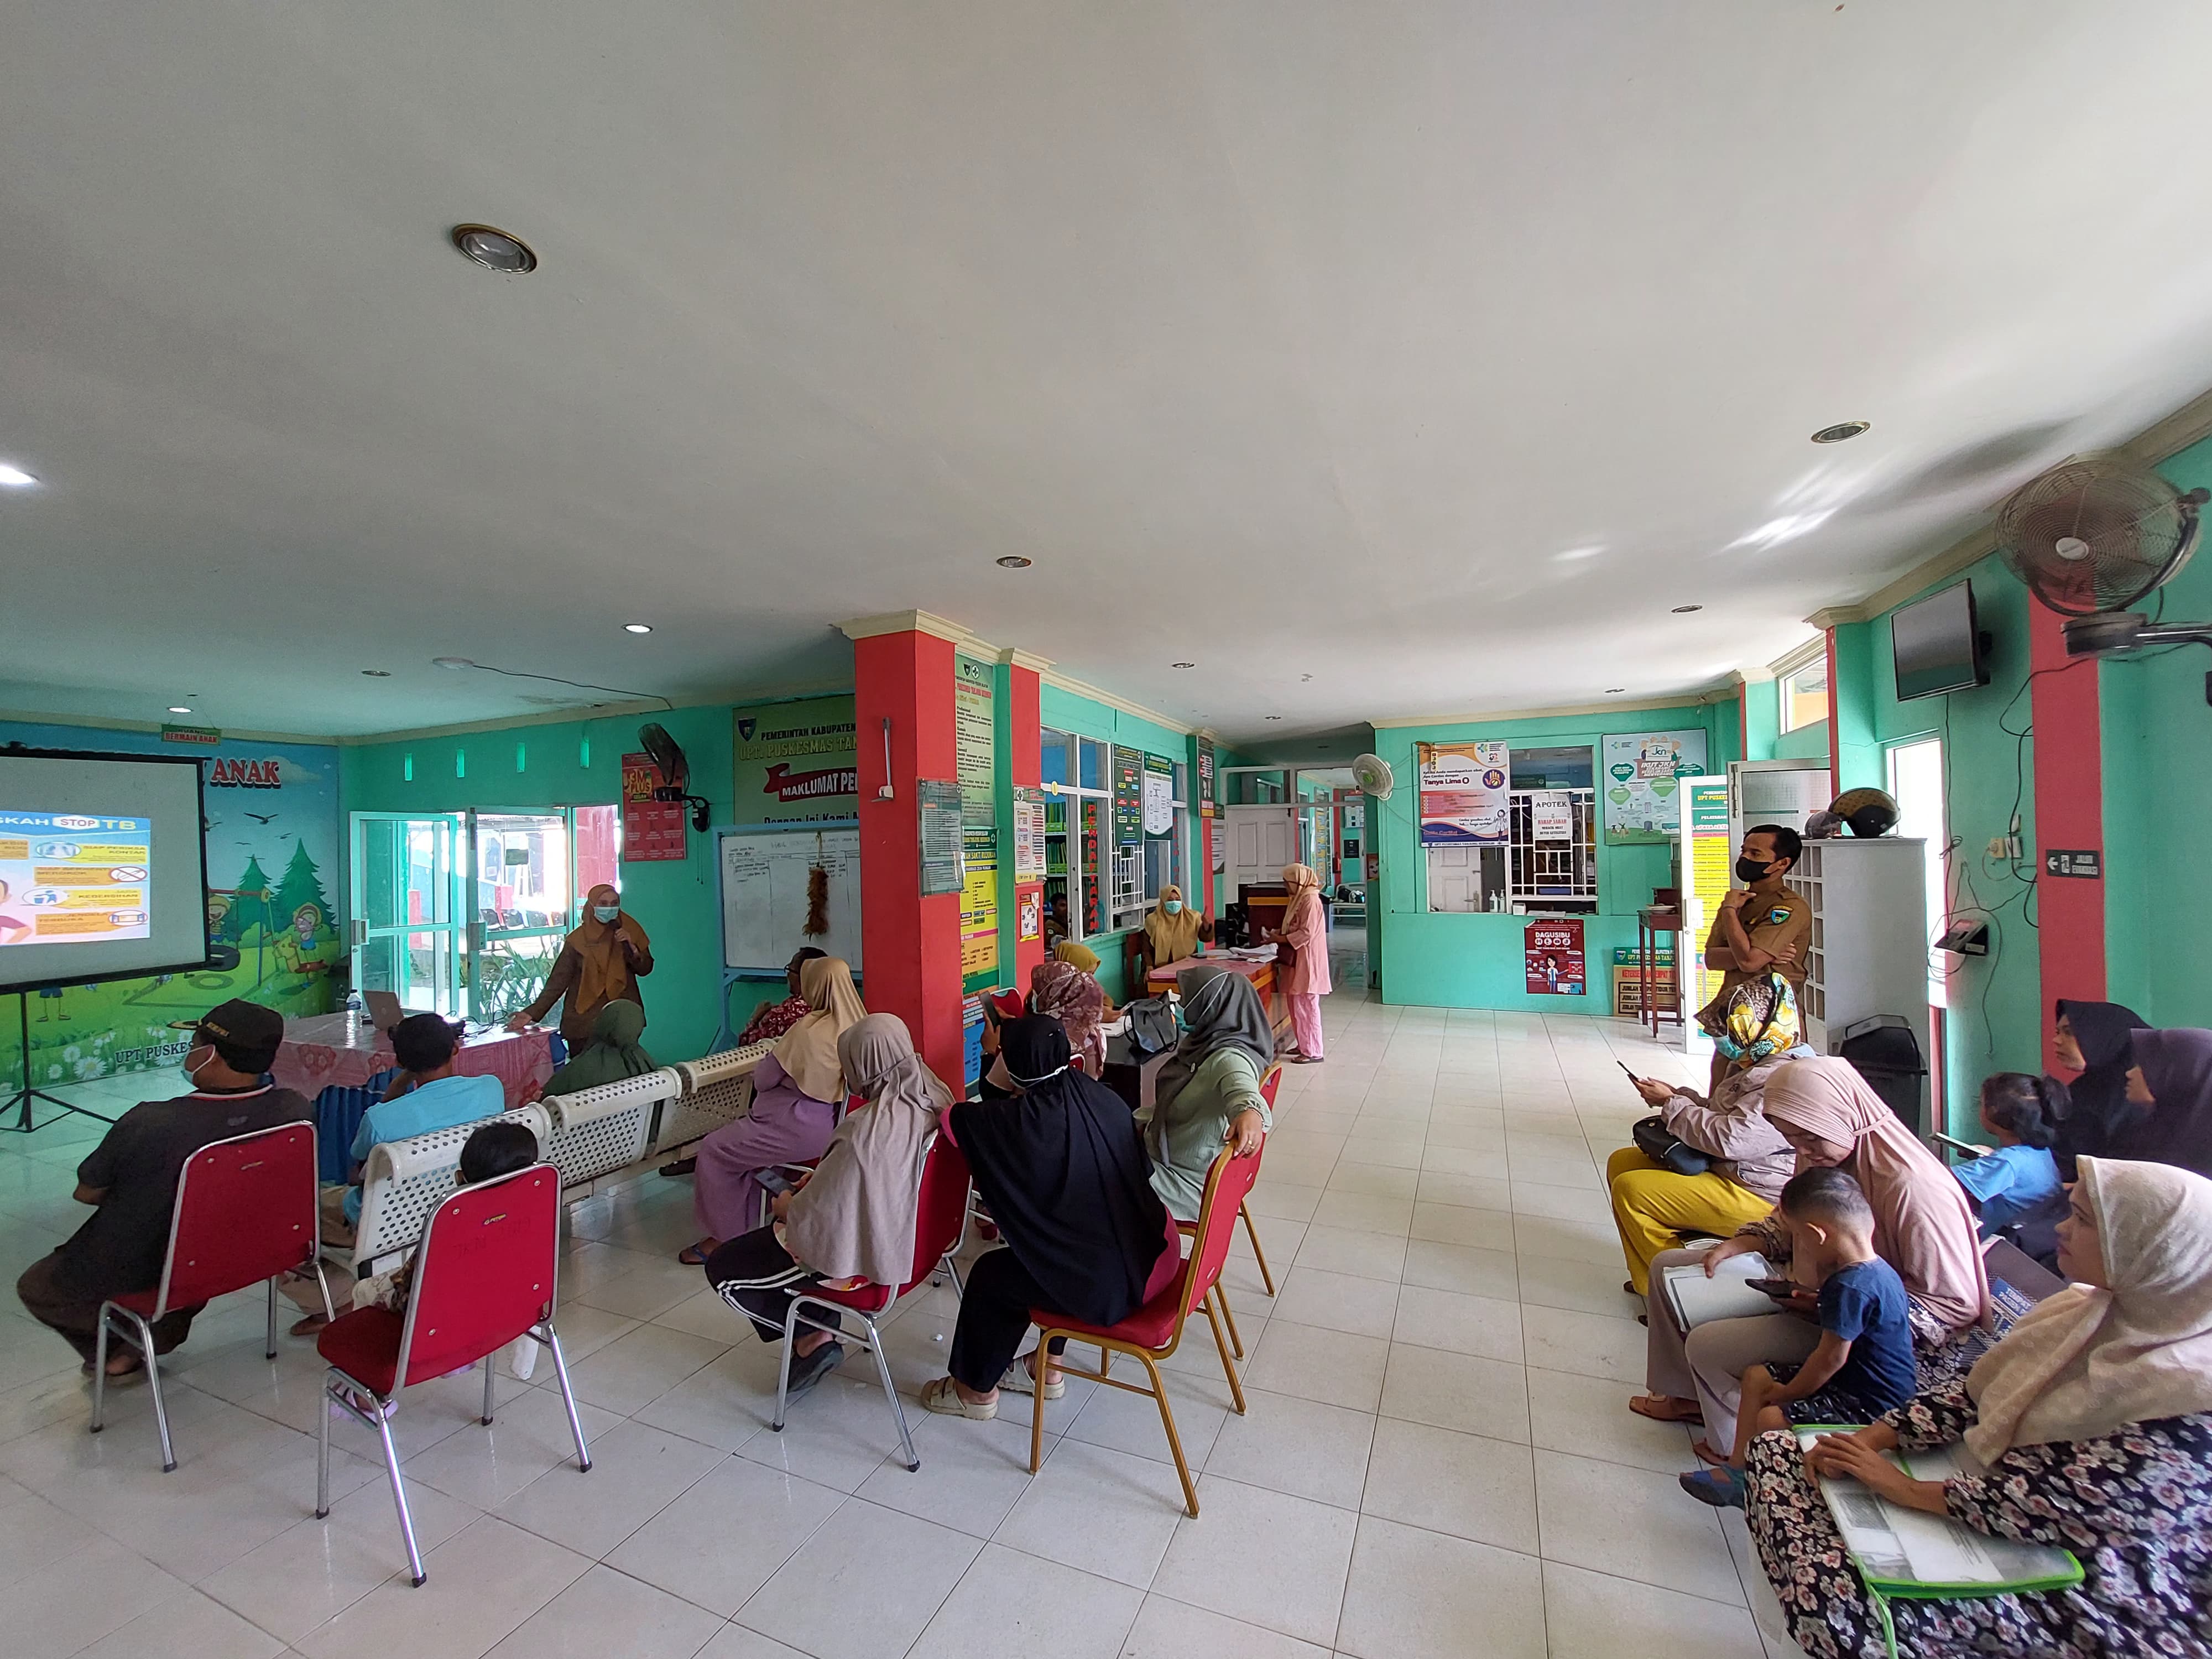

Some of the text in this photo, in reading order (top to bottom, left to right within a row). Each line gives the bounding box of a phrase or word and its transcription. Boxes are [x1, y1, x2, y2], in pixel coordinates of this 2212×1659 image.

[165, 733, 197, 742] BERMAIN
[761, 723, 857, 741] PEMERINTAH KABUPATEN
[739, 747, 763, 761] UPT.
[766, 738, 834, 758] PUSKESMAS
[211, 758, 281, 788] ANAK
[630, 782, 651, 794] PLUS
[782, 773, 838, 796] MAKLUMAT
[0, 817, 137, 830] KAH STOP TB
[1088, 804, 1099, 930] PENDAFTARAN
[116, 1041, 194, 1063] UPT PUSKES
